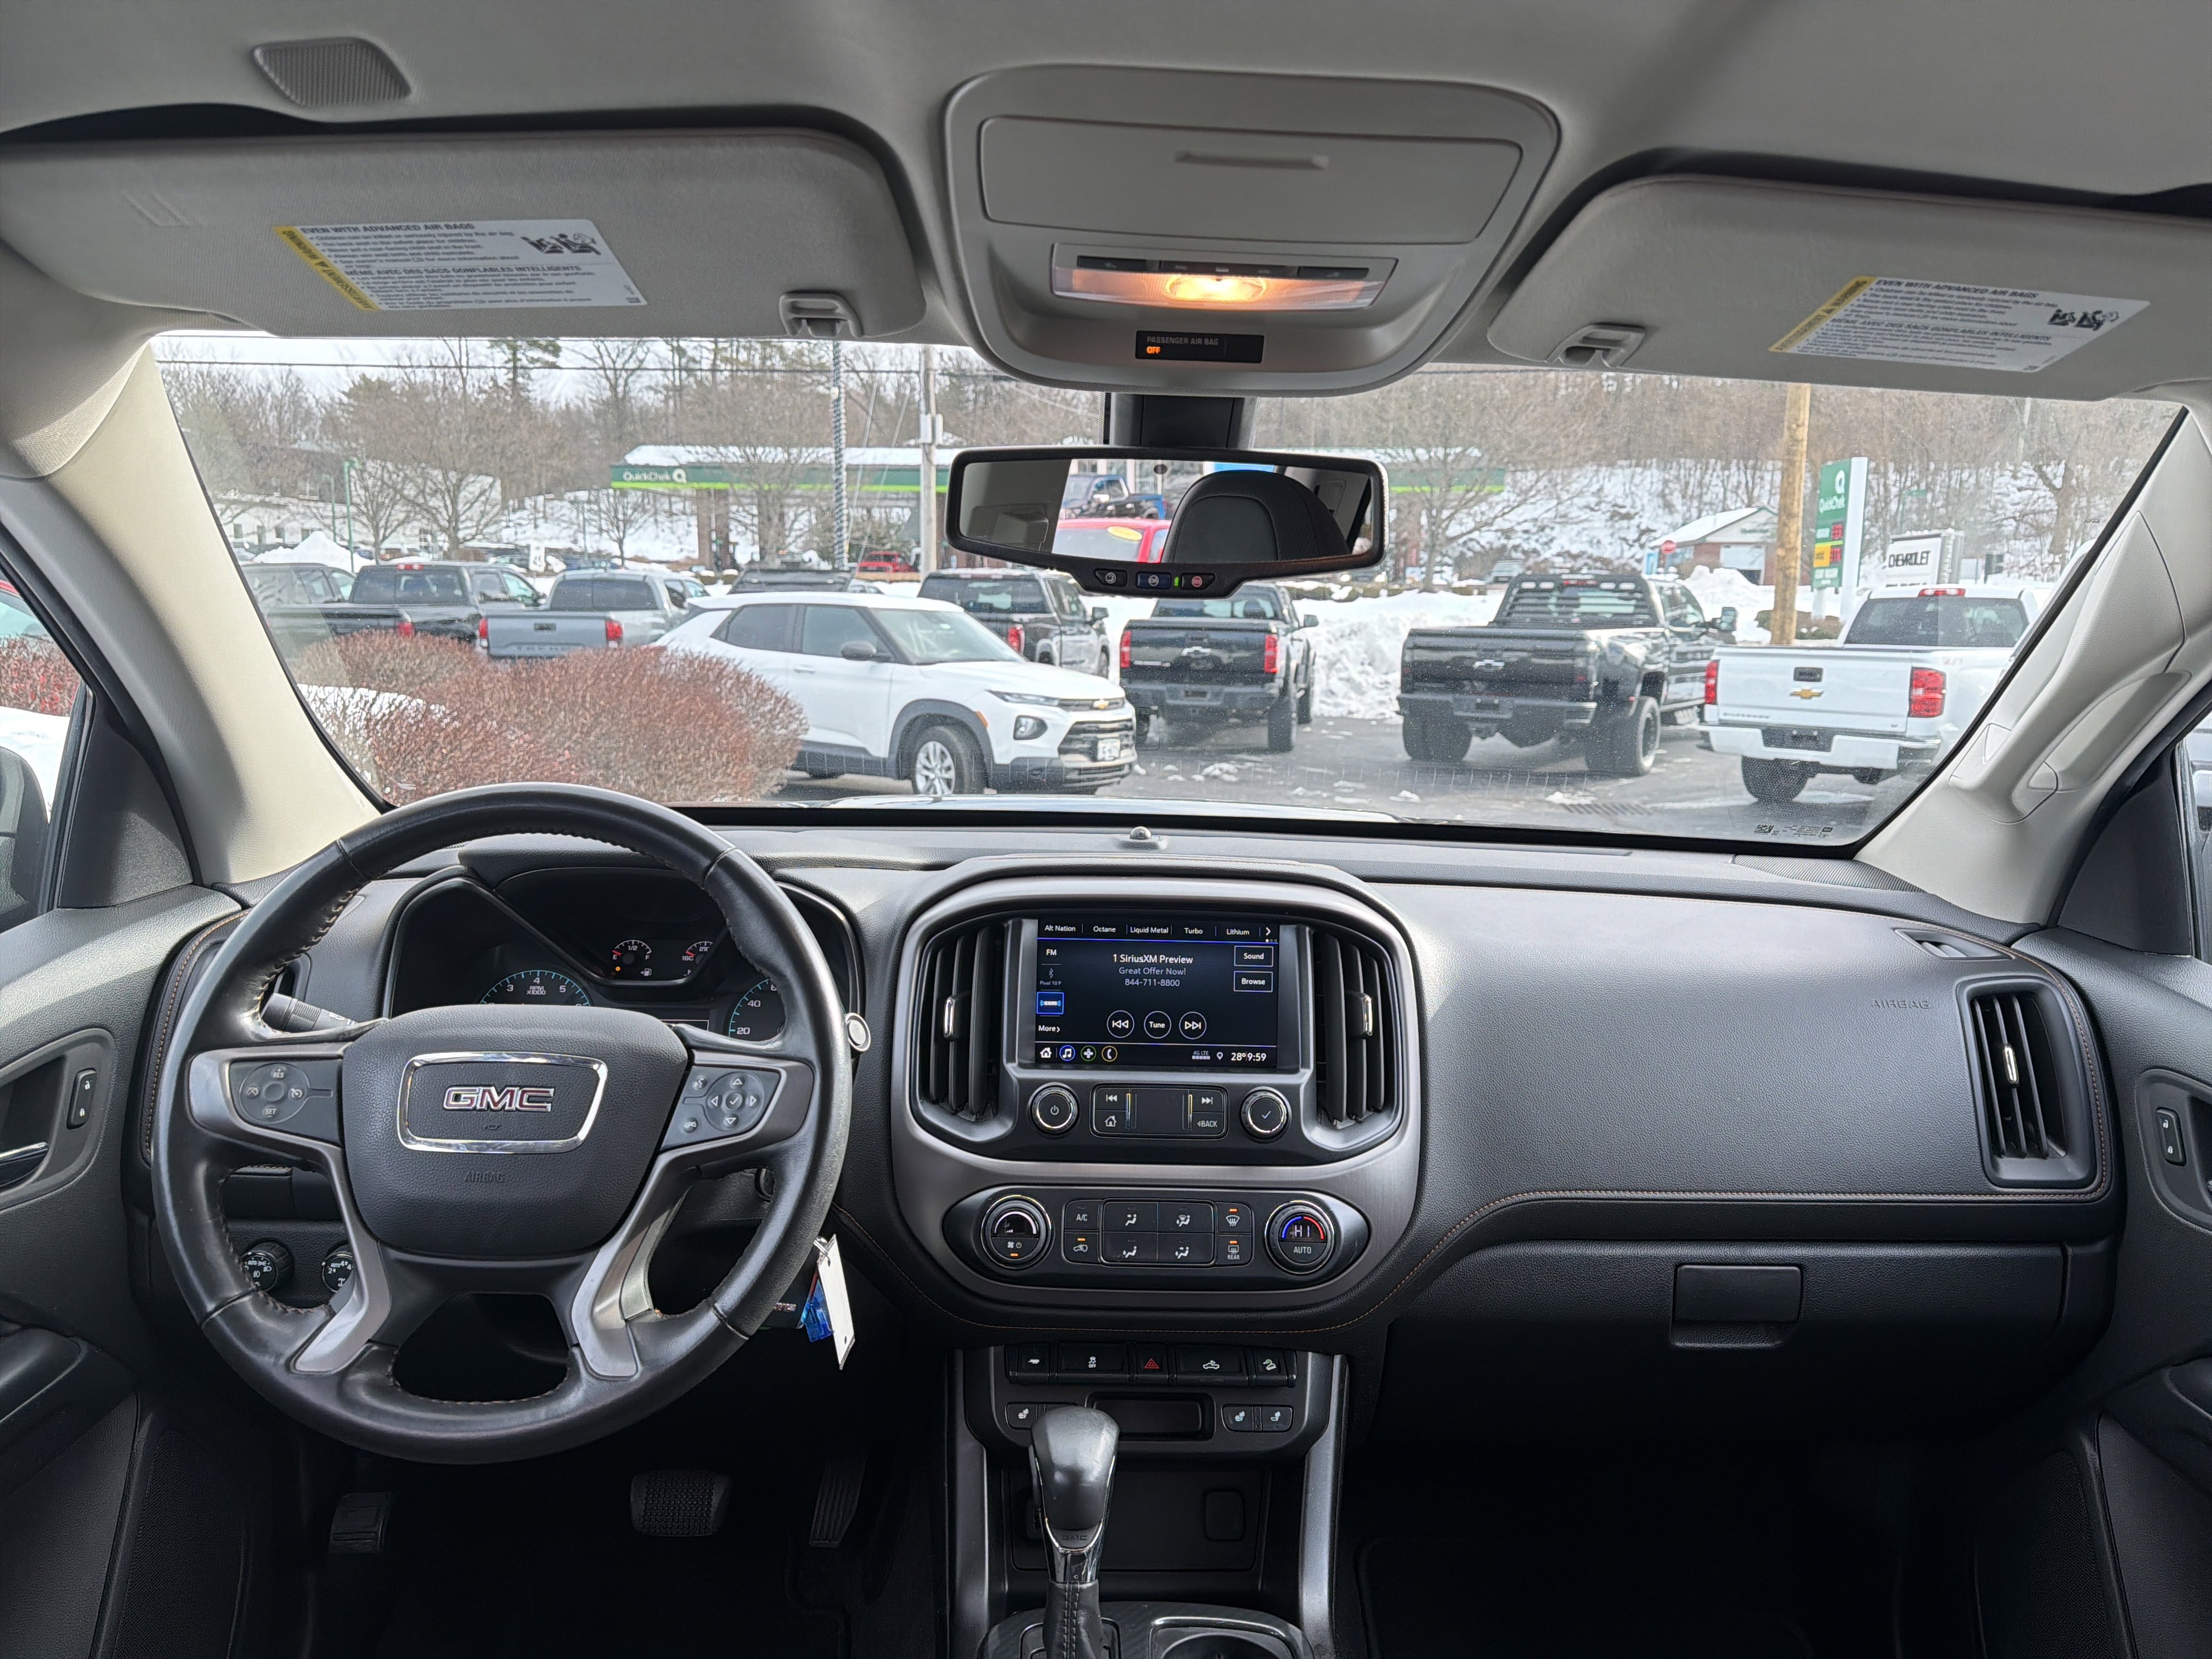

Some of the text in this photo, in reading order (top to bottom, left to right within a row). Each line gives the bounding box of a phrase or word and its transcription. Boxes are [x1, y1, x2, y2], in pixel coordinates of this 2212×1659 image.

[1932, 284, 1989, 295] ADVANCED
[1147, 336, 1188, 345] PASSENGER
[1146, 346, 1161, 354] OFF
[1113, 954, 1193, 964] 1 SiriusXM Preview
[1143, 967, 1164, 975] Offer
[1125, 978, 1180, 987] 844-711-8800
[1871, 998, 1930, 1009] AIRBAG
[1247, 1053, 1267, 1062] 9:59
[443, 1084, 555, 1113] GMC
[1201, 1120, 1218, 1128] BACK
[464, 1171, 505, 1184] AIRBAG
[1076, 1212, 1088, 1222] A/C
[1293, 1246, 1312, 1255] AUTO
